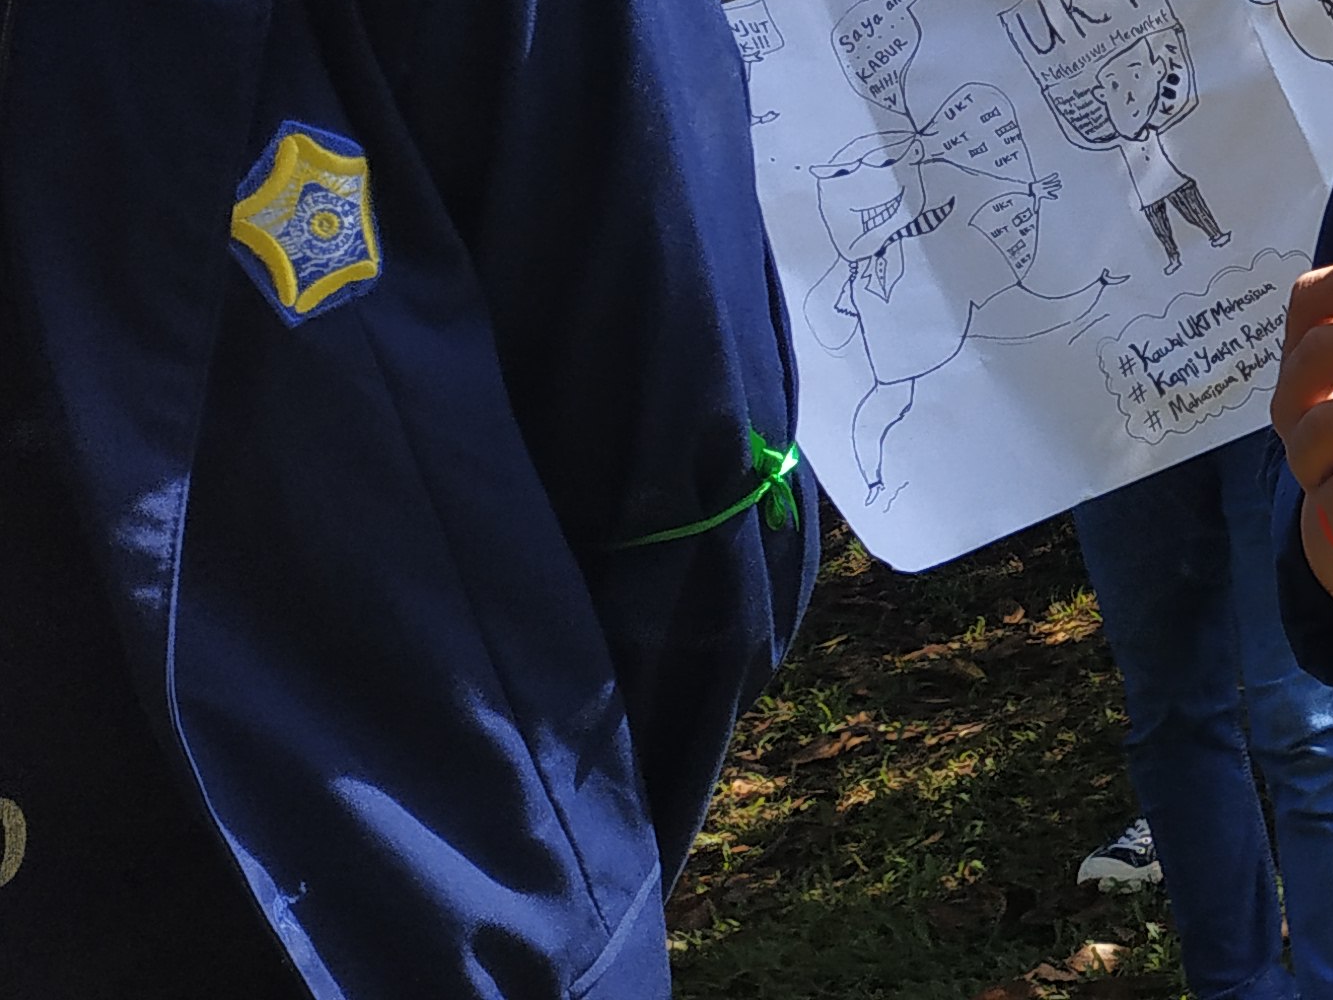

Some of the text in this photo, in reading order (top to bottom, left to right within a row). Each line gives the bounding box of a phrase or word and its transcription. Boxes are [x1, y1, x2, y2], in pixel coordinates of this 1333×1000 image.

[839, 14, 883, 53] Saya
[855, 37, 908, 84] KABUR
[944, 93, 974, 121] UKT
[942, 131, 970, 151] UKT
[994, 151, 1019, 168] UKT
[992, 199, 1014, 213] UKT
[1178, 308, 1214, 340] UKT
[1211, 281, 1277, 326] Mahasiswa
[1195, 339, 1244, 373] Yakin
